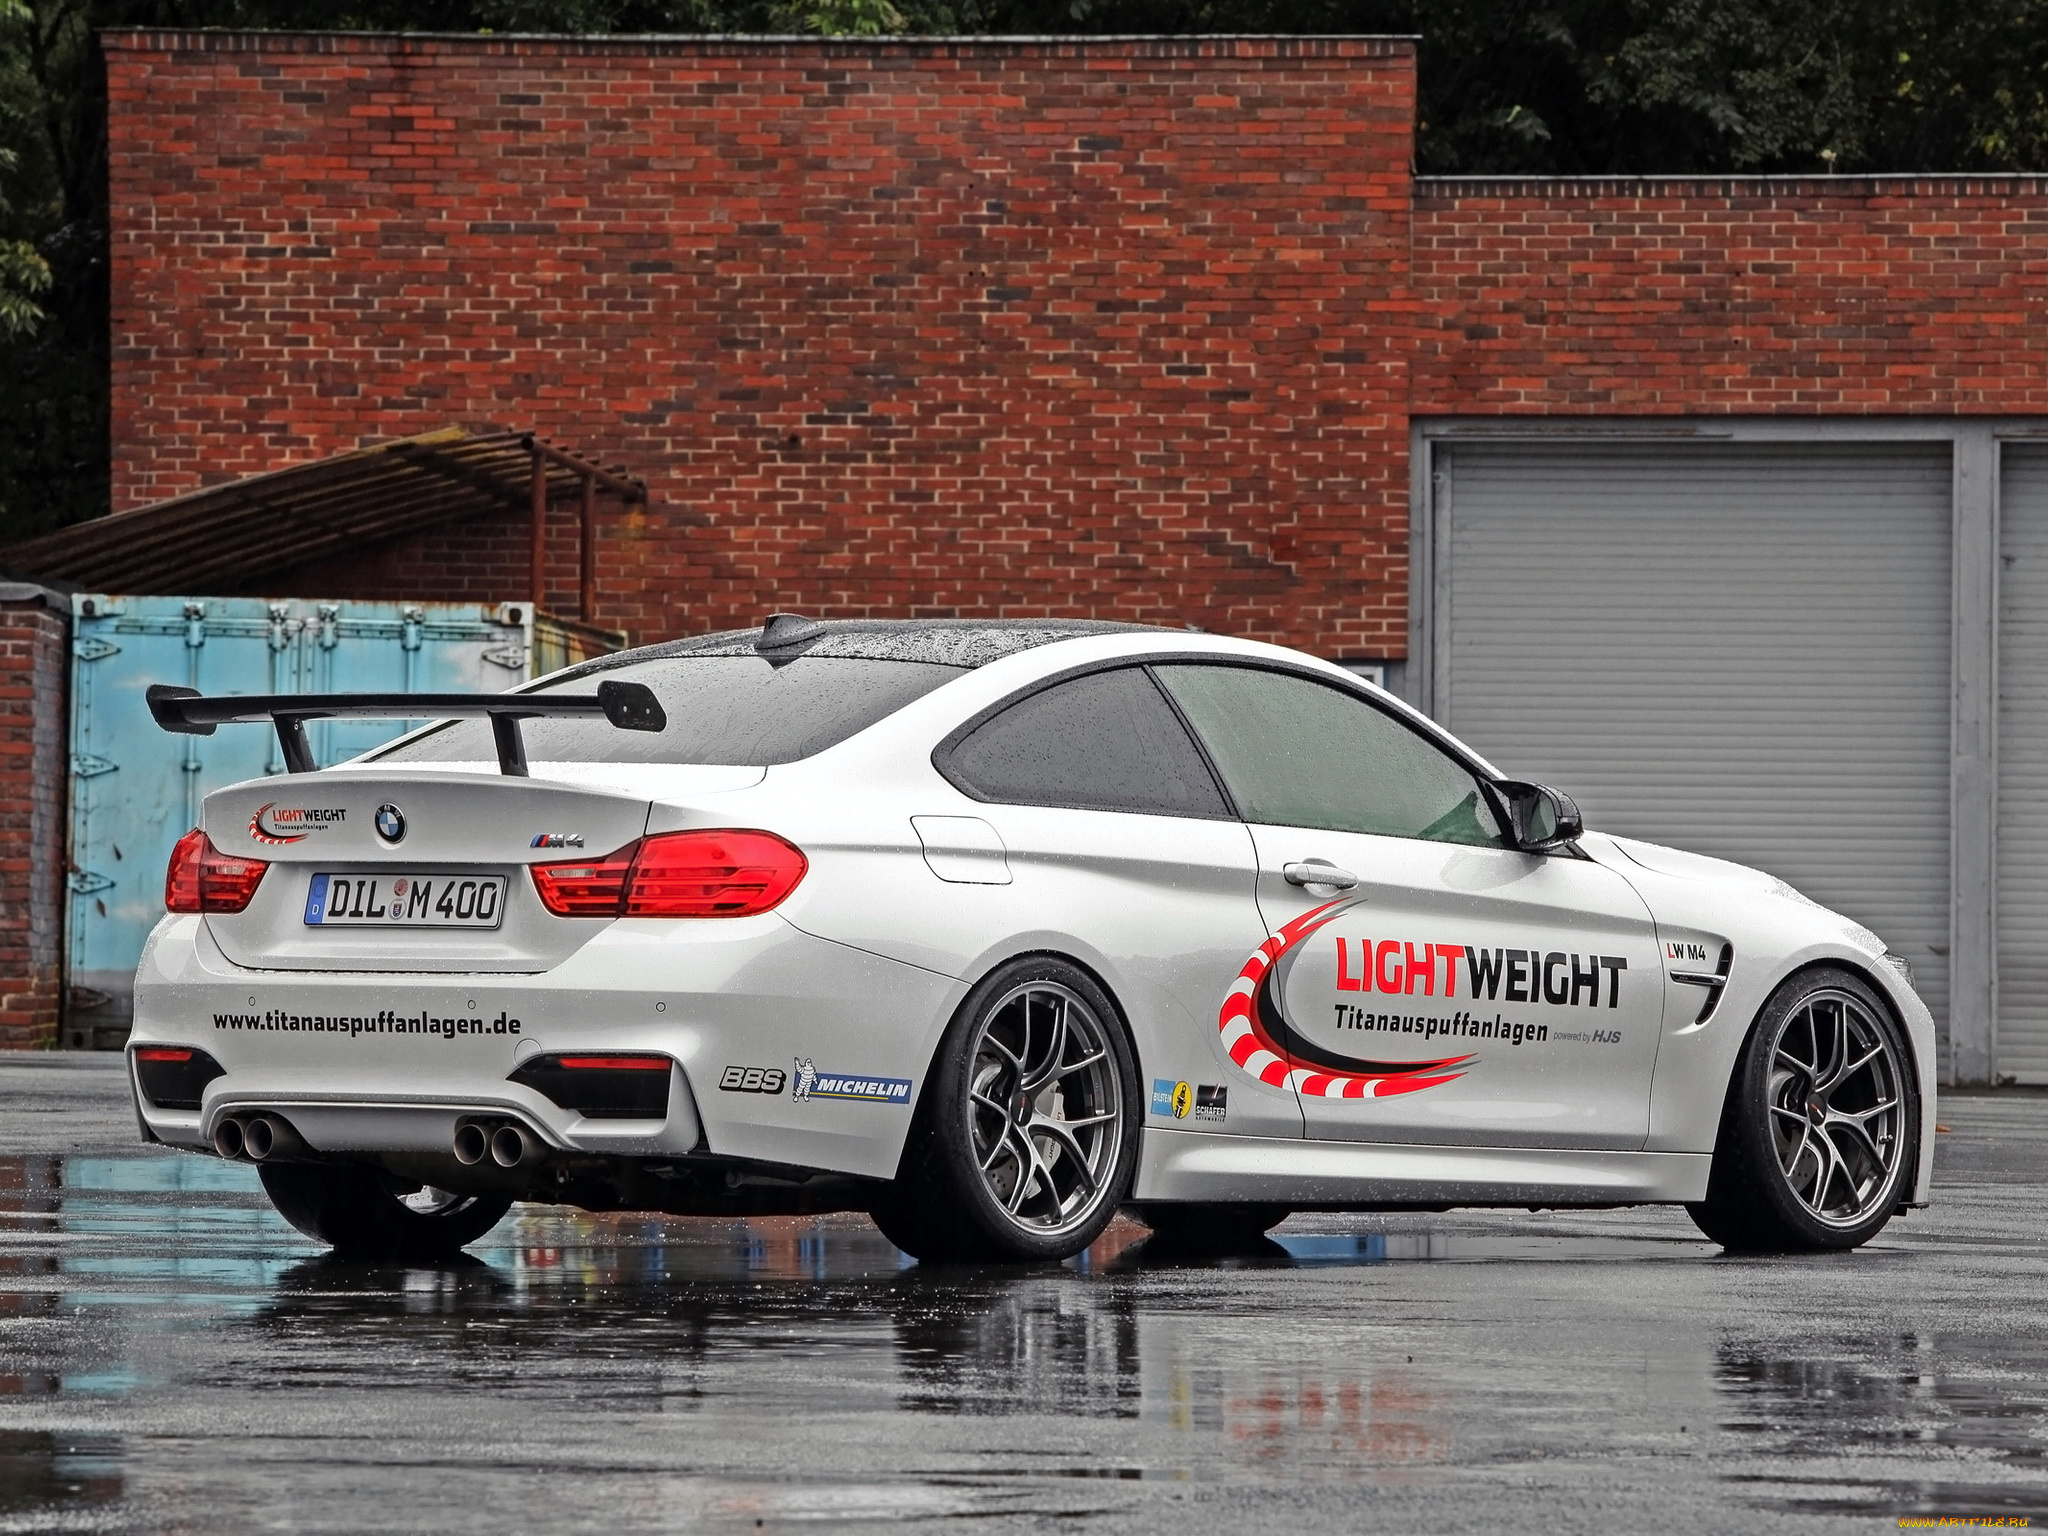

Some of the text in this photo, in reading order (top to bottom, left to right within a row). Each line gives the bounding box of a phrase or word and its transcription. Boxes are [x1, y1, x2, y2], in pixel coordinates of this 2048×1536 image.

[272, 808, 346, 821] LIGHTWEIGHT
[546, 833, 584, 849] M4
[311, 904, 320, 915] D
[327, 879, 498, 919] DIL M 400
[1666, 942, 1706, 961] LW M4
[1335, 936, 1628, 1009] LIGHTWEIGHT
[213, 1009, 521, 1039] www.titanauspuffanlagen.de
[1334, 1003, 1622, 1046] Titanauspuffanlagen powered by HJS
[719, 1065, 787, 1095] BBS
[816, 1078, 909, 1097] MICHELIN
